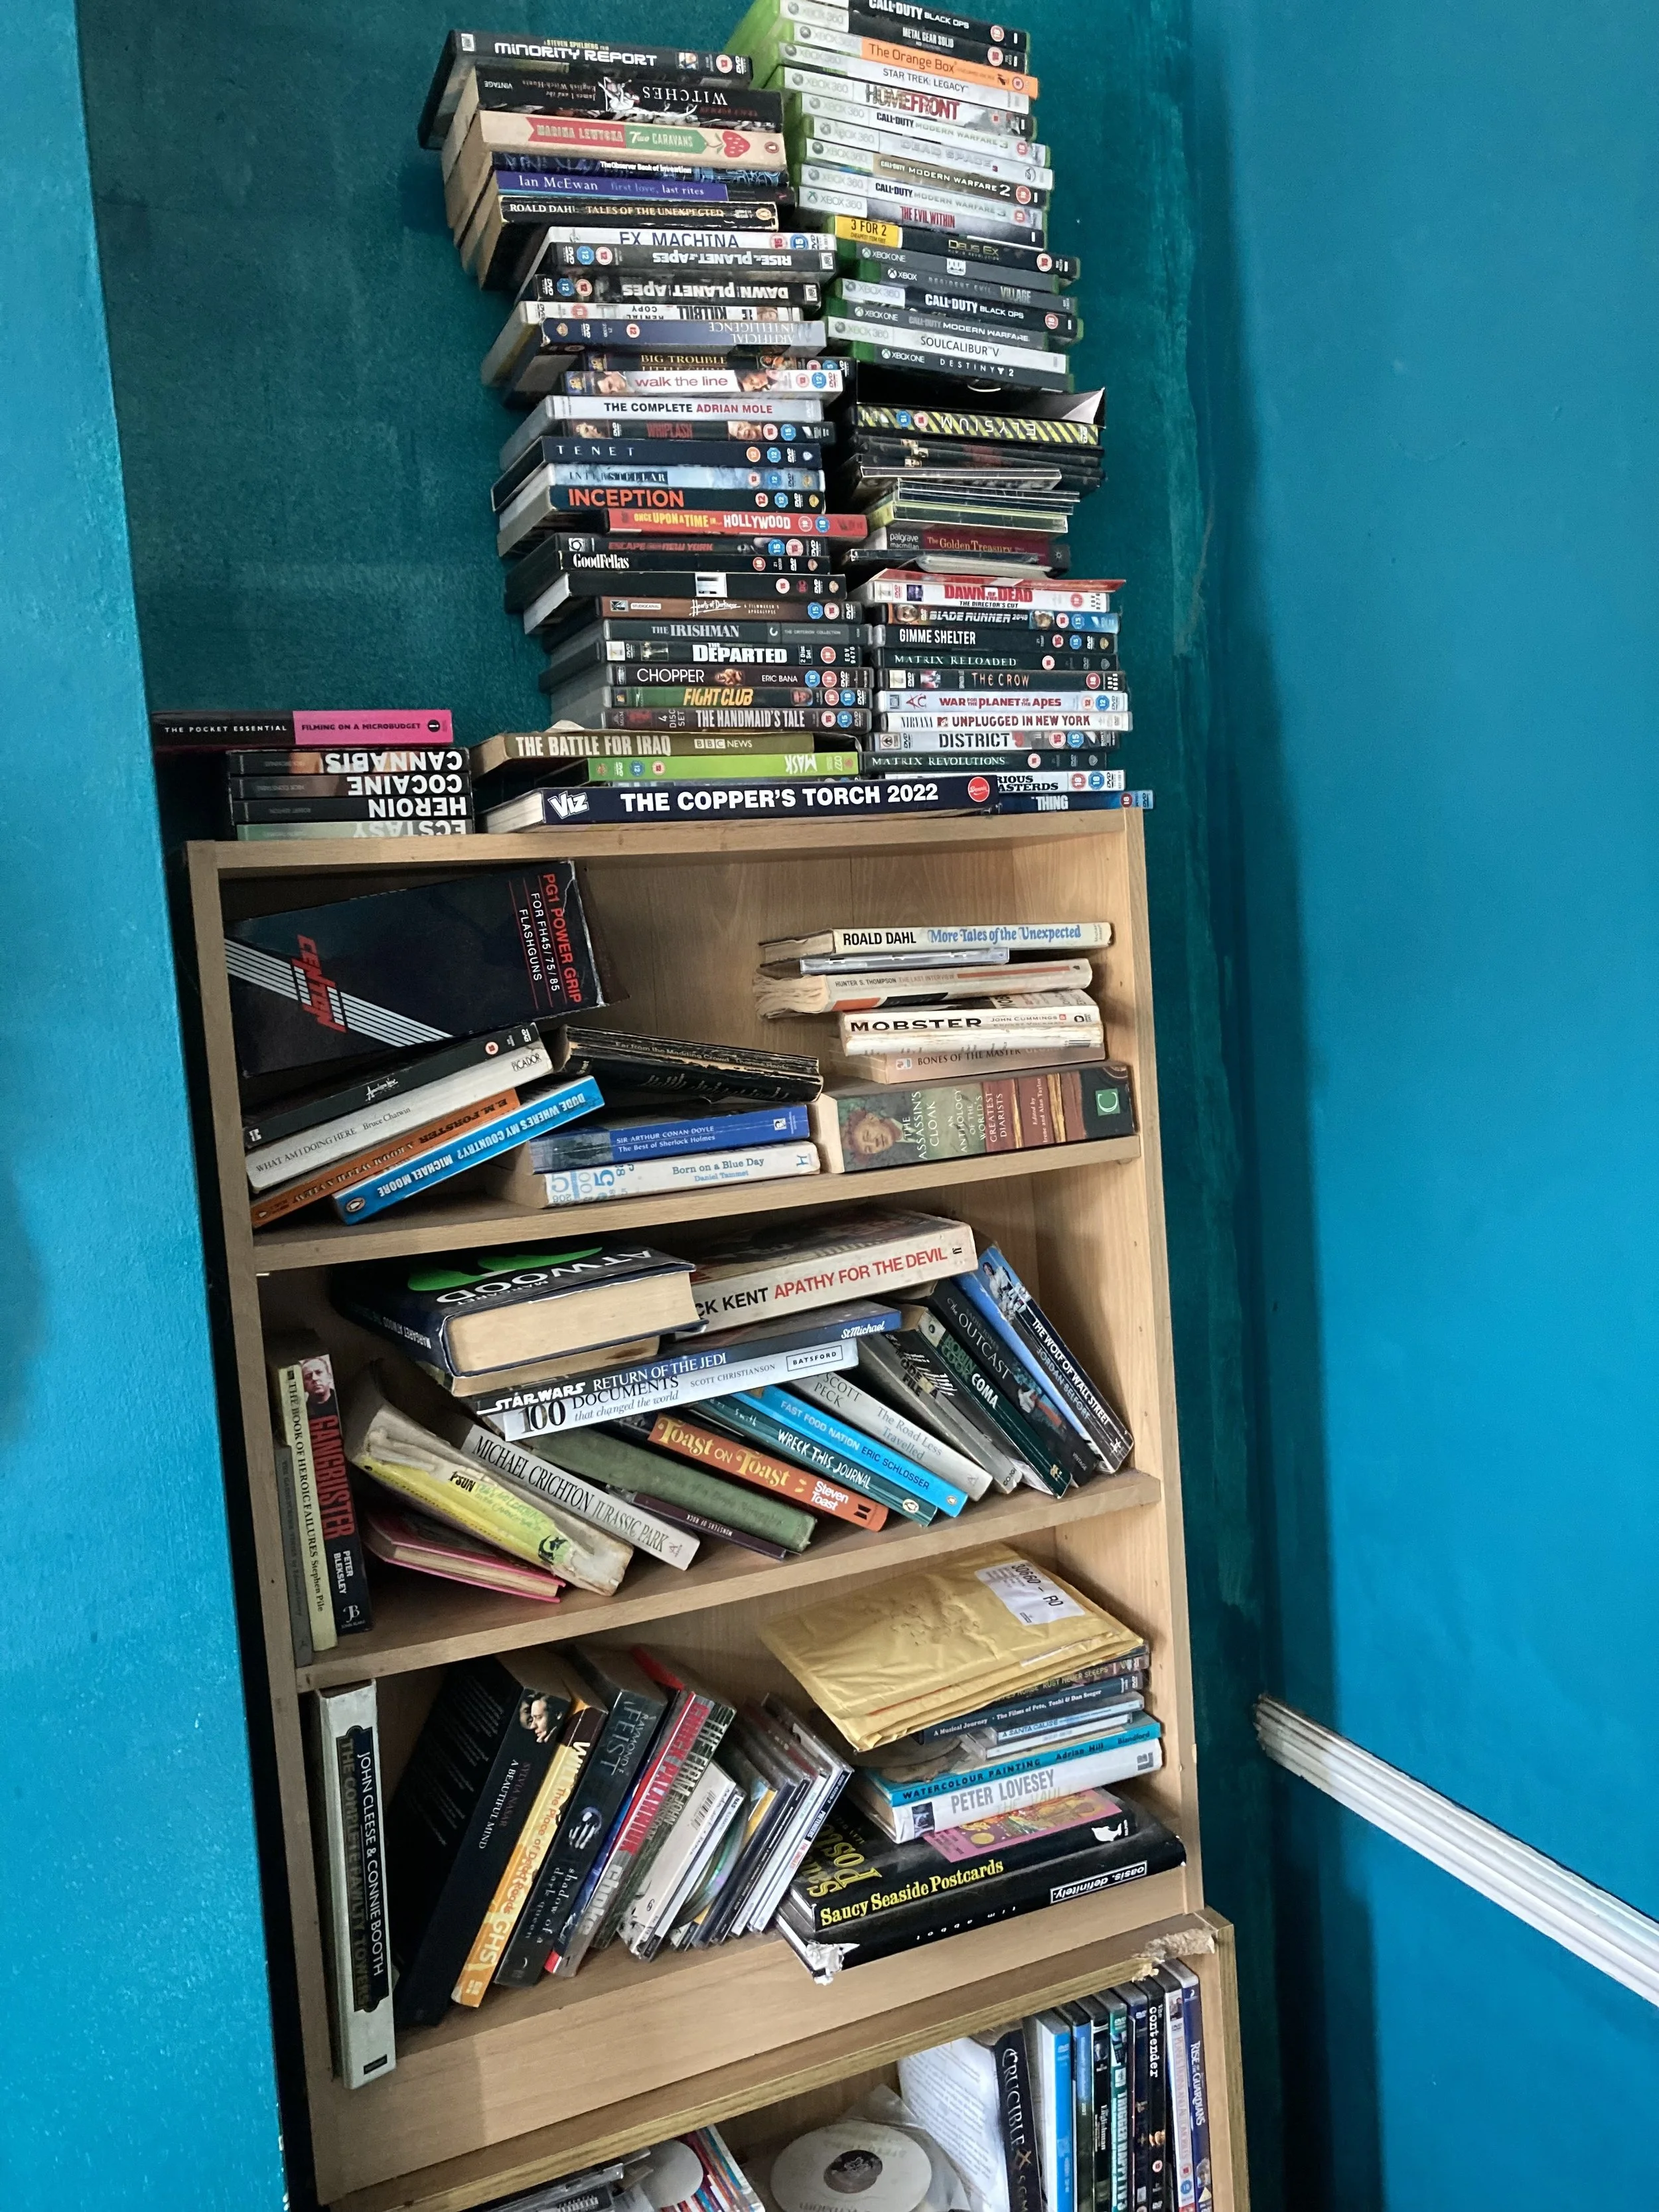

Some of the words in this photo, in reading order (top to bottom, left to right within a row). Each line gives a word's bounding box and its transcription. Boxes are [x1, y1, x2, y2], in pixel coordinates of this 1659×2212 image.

[902, 27, 920, 40] METAL
[921, 30, 936, 44] GEAR
[937, 33, 954, 48] SOLID
[585, 49, 657, 66] REPORT
[644, 86, 728, 106] WITCHES
[866, 84, 962, 121] HOMEFRONT
[708, 322, 794, 332] INTELLIGENCE
[731, 334, 794, 344] ARTIFICIAL
[634, 376, 672, 387] walk
[674, 376, 699, 386] the
[701, 376, 729, 386] line
[604, 402, 627, 412] THE
[631, 403, 693, 413] COMPLETE
[697, 404, 739, 413] ADRIAN
[743, 404, 773, 413] MOLE
[941, 416, 1037, 437] ELYSIUM
[569, 488, 685, 508] INCEPTION
[889, 533, 919, 545] palgrave
[573, 553, 630, 569] GoodFellas
[944, 585, 986, 601] DAWN
[997, 588, 1034, 603] DEAD
[652, 626, 670, 635] THE
[670, 624, 740, 638] IRISHMAN
[899, 628, 932, 643] GIMME
[934, 630, 976, 645] SHELTER
[692, 644, 788, 664] DEPARTED
[895, 654, 944, 665] MATRIX
[950, 656, 1017, 667] RELOADED
[636, 668, 705, 684] CHOPPER
[761, 674, 777, 683] ERIC
[972, 672, 993, 686] THE
[998, 673, 1030, 688] CROW
[696, 709, 716, 727] THE
[717, 710, 781, 727] HANDMAID'S
[782, 710, 805, 727] TALE
[901, 715, 934, 729] NIRVANA
[952, 716, 1019, 727] UNPLUGGED
[1022, 716, 1033, 727] IN
[1036, 715, 1060, 727] NEW
[1061, 715, 1091, 726] YORK
[515, 736, 543, 757] THE
[547, 736, 600, 757] BATTLE
[605, 735, 632, 756] FOR
[636, 735, 672, 757] IRAQ
[693, 738, 726, 749] BBC
[939, 732, 1011, 749] DISTRICT
[325, 751, 463, 774] CANNABIS
[784, 755, 818, 773] MASK
[872, 757, 922, 766] MATRIX
[928, 757, 1006, 767] REVOLUTIONS
[347, 774, 463, 796] COCAINE
[368, 796, 467, 819] HEROIN
[620, 792, 670, 812] THE
[677, 789, 796, 810] COPPER'S
[802, 785, 881, 807] TORCH
[887, 782, 940, 803] 2022
[1037, 794, 1069, 810] THING
[543, 873, 561, 903] PG1
[531, 892, 544, 918] FOR
[519, 908, 543, 982] FLASHGUNS
[550, 907, 575, 964] POWER
[843, 932, 882, 947] ROALD
[887, 931, 916, 945] DAHL
[928, 930, 960, 944] More
[960, 929, 988, 944] Tales
[990, 928, 1000, 942] of
[999, 928, 1017, 942] the
[1018, 924, 1082, 942] Unexpected
[563, 966, 583, 1003] GRIP
[850, 1017, 982, 1033] MOBSTER
[512, 1053, 542, 1072] PICADOR
[910, 1090, 928, 1160] ASSASSIN'S
[927, 1100, 940, 1147] CLOAK
[954, 1088, 968, 1153] ANTHOLOGY
[986, 1091, 997, 1143] GREATEST
[995, 1092, 1007, 1138] DIARISTS
[616, 1136, 628, 1145] SIR
[630, 1133, 661, 1143] ARTHUR
[662, 1130, 690, 1140] CONAN
[691, 1126, 715, 1136] DOYLE
[436, 1249, 654, 1303] ATWOOD
[693, 1299, 718, 1318] CK
[721, 1288, 768, 1313] KENT
[774, 1272, 836, 1299] APATHY
[837, 1266, 871, 1285] FOR
[871, 1257, 904, 1277] THE
[906, 1247, 948, 1270] DEVIL
[958, 1313, 1011, 1380] OUTCAST
[792, 1351, 837, 1366] BATSFORD
[689, 1376, 715, 1388] SCOTT
[717, 1364, 776, 1382] CHRISTIANSON
[813, 1382, 842, 1408] PECK
[971, 1372, 999, 1410] COMA
[518, 1399, 566, 1435] 100
[572, 1375, 680, 1410] DOCUMENTS
[574, 1410, 595, 1423] that
[595, 1399, 635, 1421] changed
[636, 1398, 652, 1410] the
[652, 1390, 680, 1407] world
[780, 1400, 803, 1418] FAST
[803, 1412, 828, 1432] FOOD
[827, 1426, 861, 1451] NATION
[860, 1445, 881, 1465] ERIC
[881, 1457, 930, 1491] SCHLOSSER
[658, 1418, 715, 1455] Toast
[713, 1447, 734, 1464] ON
[735, 1450, 790, 1487] Toast
[814, 1479, 849, 1504] Steven
[777, 1428, 809, 1455] WRECK
[808, 1445, 835, 1470] THIS
[831, 1461, 871, 1491] JOURNAL
[309, 1414, 356, 1541] GANGBUSTER
[470, 1435, 529, 1482] MICHAEL
[526, 1463, 596, 1514] CRICHTON
[593, 1499, 640, 1540] JURASSIC
[636, 1526, 670, 1555] PARK
[810, 1490, 839, 1512] Toast
[685, 1514, 699, 1524] ROCK
[707, 1523, 733, 1537] MONSTERS
[333, 1552, 347, 1595] BLEKSLEY
[342, 1550, 354, 1578] PETER
[1042, 1678, 1060, 1690] RUST
[1060, 1672, 1084, 1686] NEVER
[1084, 1666, 1109, 1680] SLEEPS
[356, 1751, 374, 1793] JOHN
[902, 1773, 983, 1800] WATERCOLOUR
[987, 1757, 1041, 1779] PAINTING
[1055, 1748, 1085, 1762] Adrian
[1088, 1742, 1104, 1755] Hill
[1116, 1730, 1150, 1745] Blandford
[950, 1788, 994, 1814] PETER
[998, 1769, 1056, 1800] LOVESEY
[362, 1795, 378, 1846] CLEESE
[366, 1846, 378, 1858] &
[366, 1859, 382, 1921] CONNIE
[819, 1901, 869, 1927] Saucy
[870, 1881, 930, 1912] Seaside
[930, 1858, 1005, 1893] Postcards
[370, 1919, 384, 1977] BOOTH
[1148, 2006, 1159, 2079] contender
[1001, 2047, 1025, 2147] CRUCIBLE
